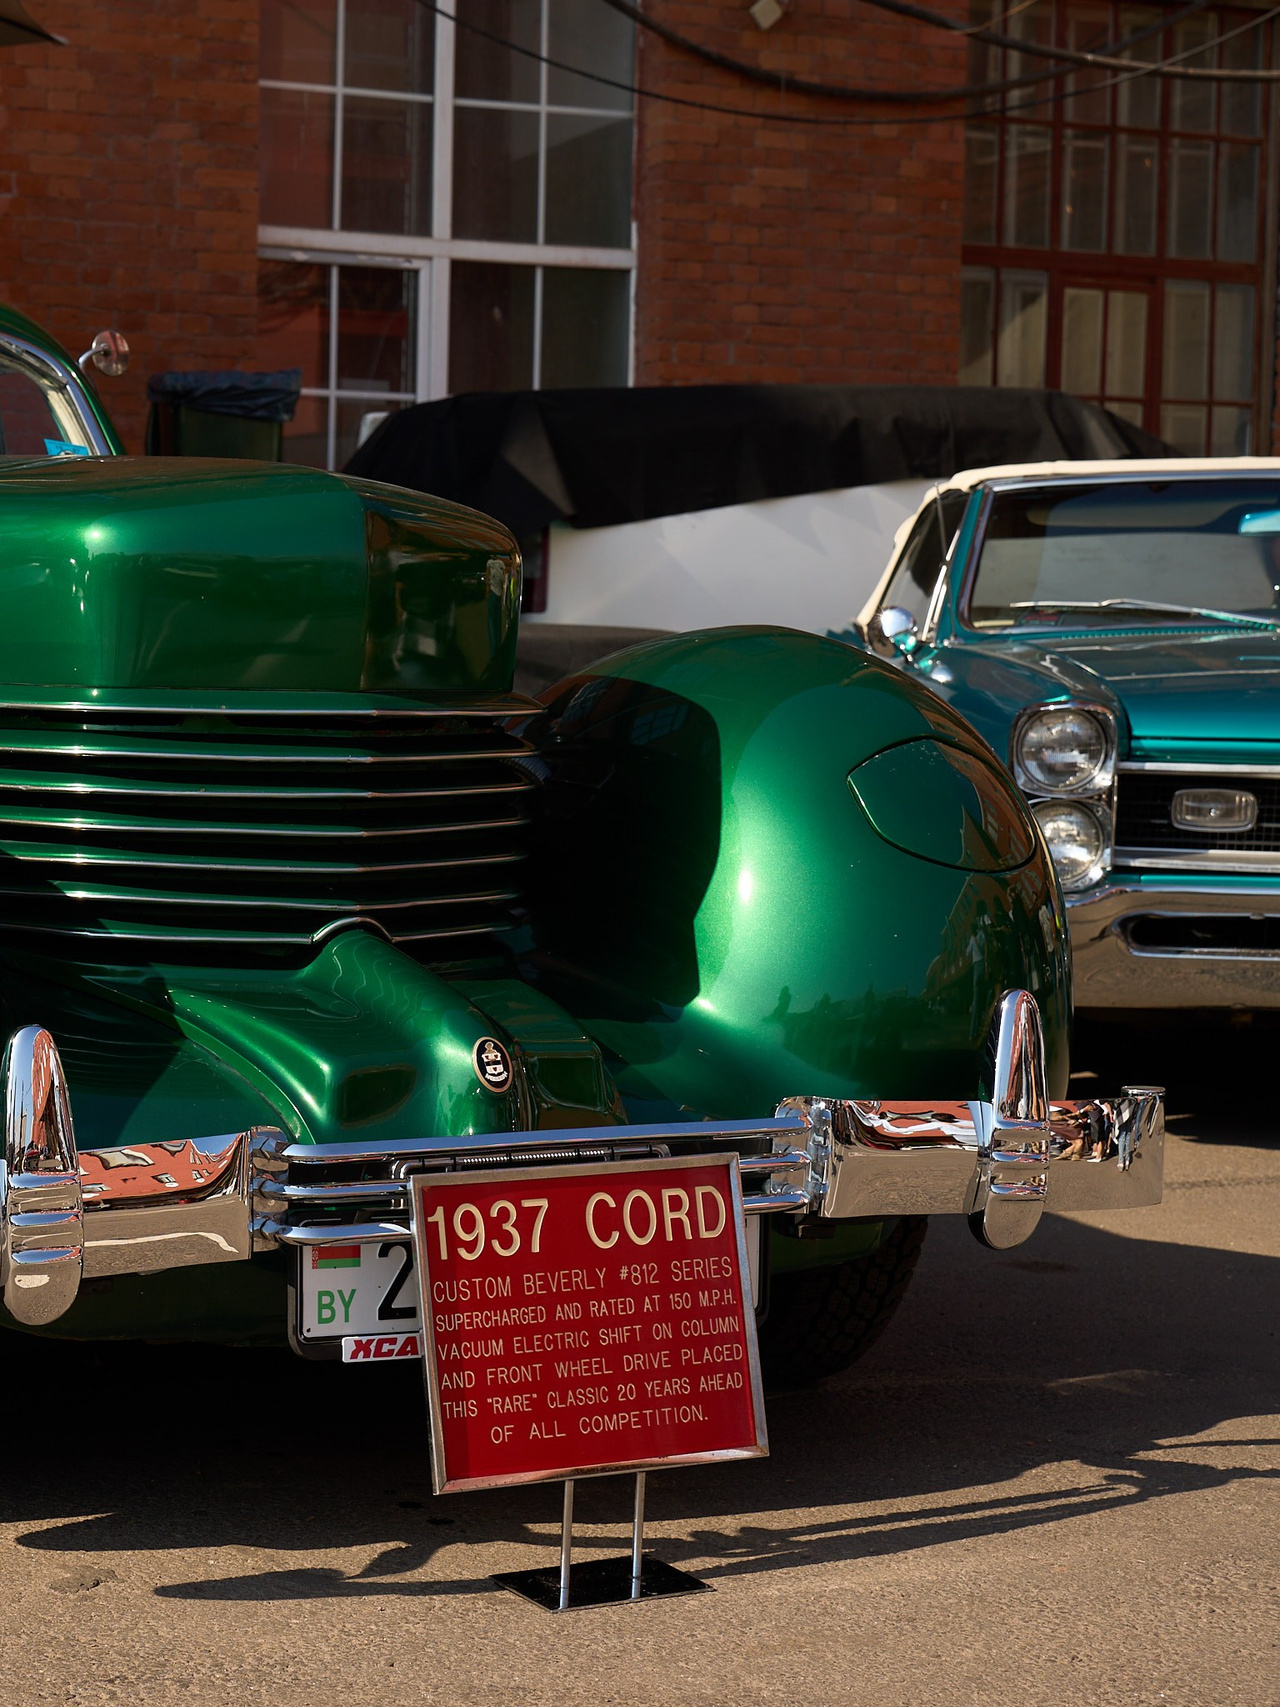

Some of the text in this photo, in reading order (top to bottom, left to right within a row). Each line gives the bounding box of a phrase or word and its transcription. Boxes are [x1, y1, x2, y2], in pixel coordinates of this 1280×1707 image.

[428, 1186, 726, 1260] 1937 CORD
[434, 1257, 732, 1302] CUSTOM BEVERLY #812 SERIES
[317, 1288, 357, 1324] BY
[436, 1289, 736, 1331] SUPERCHARGED AND RATED AT 150 M.P.H.
[438, 1316, 739, 1360] VACUUM ELECTRIC SHIFT ON COLUMN
[442, 1344, 742, 1390] AND FRONT WHEEL DRIVE PLACED
[443, 1372, 742, 1418] THIS "RARE" CLASSIC 20 YEARS AHEAD
[491, 1405, 708, 1443] OF ALL COMPETITION.
